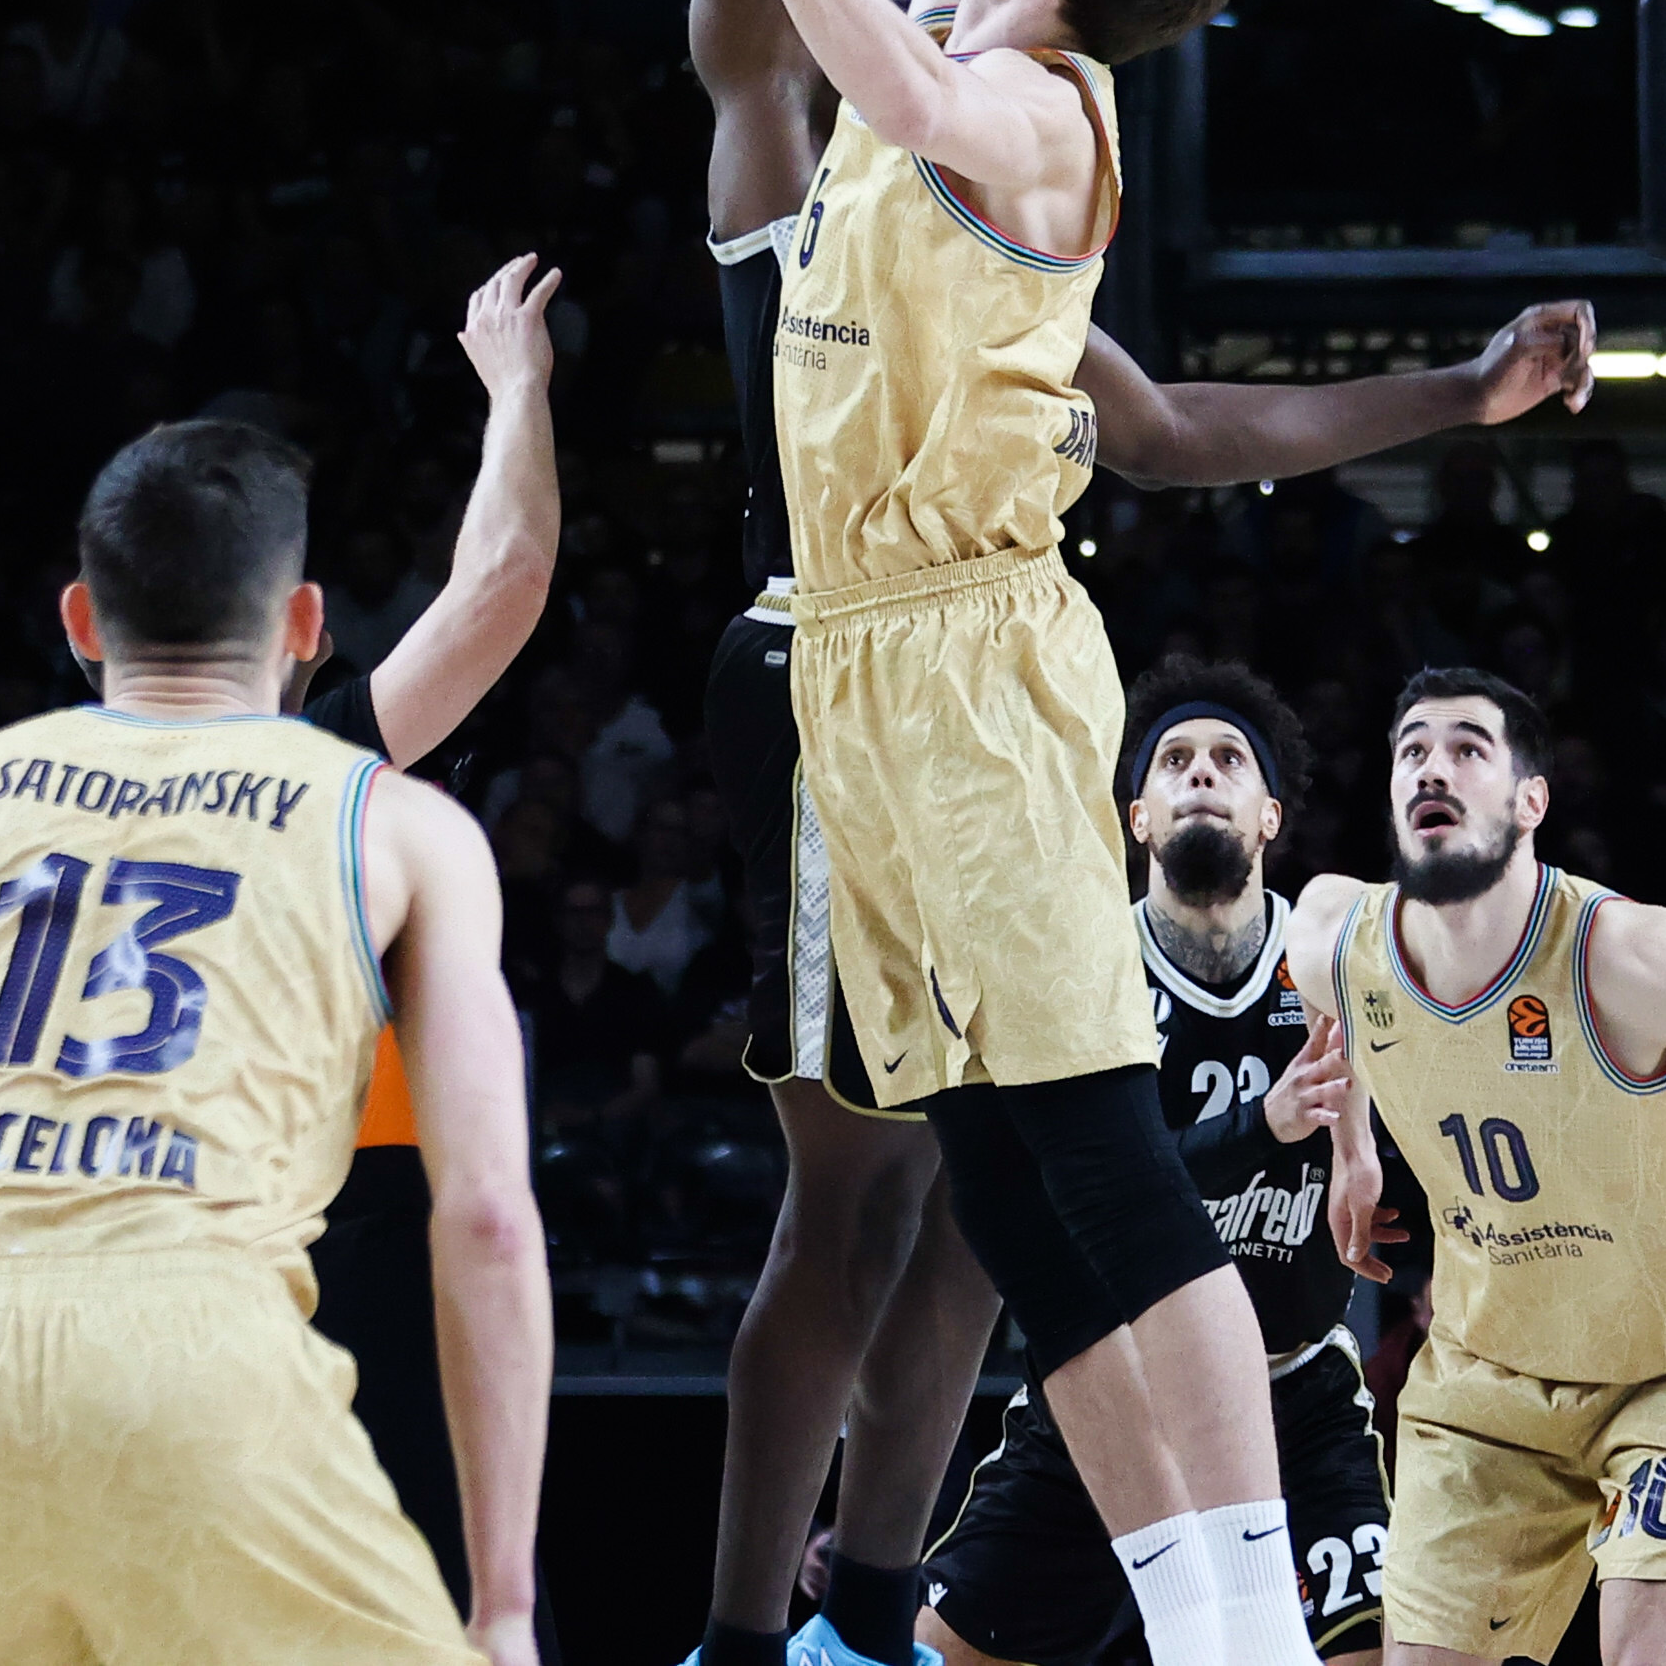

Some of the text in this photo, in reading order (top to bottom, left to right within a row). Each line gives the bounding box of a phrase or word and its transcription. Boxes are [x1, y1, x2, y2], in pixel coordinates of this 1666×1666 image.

[1438, 1113, 1541, 1203] 10
[1229, 1241, 1294, 1264] ANETTI
[1306, 1522, 1390, 1618] 23
